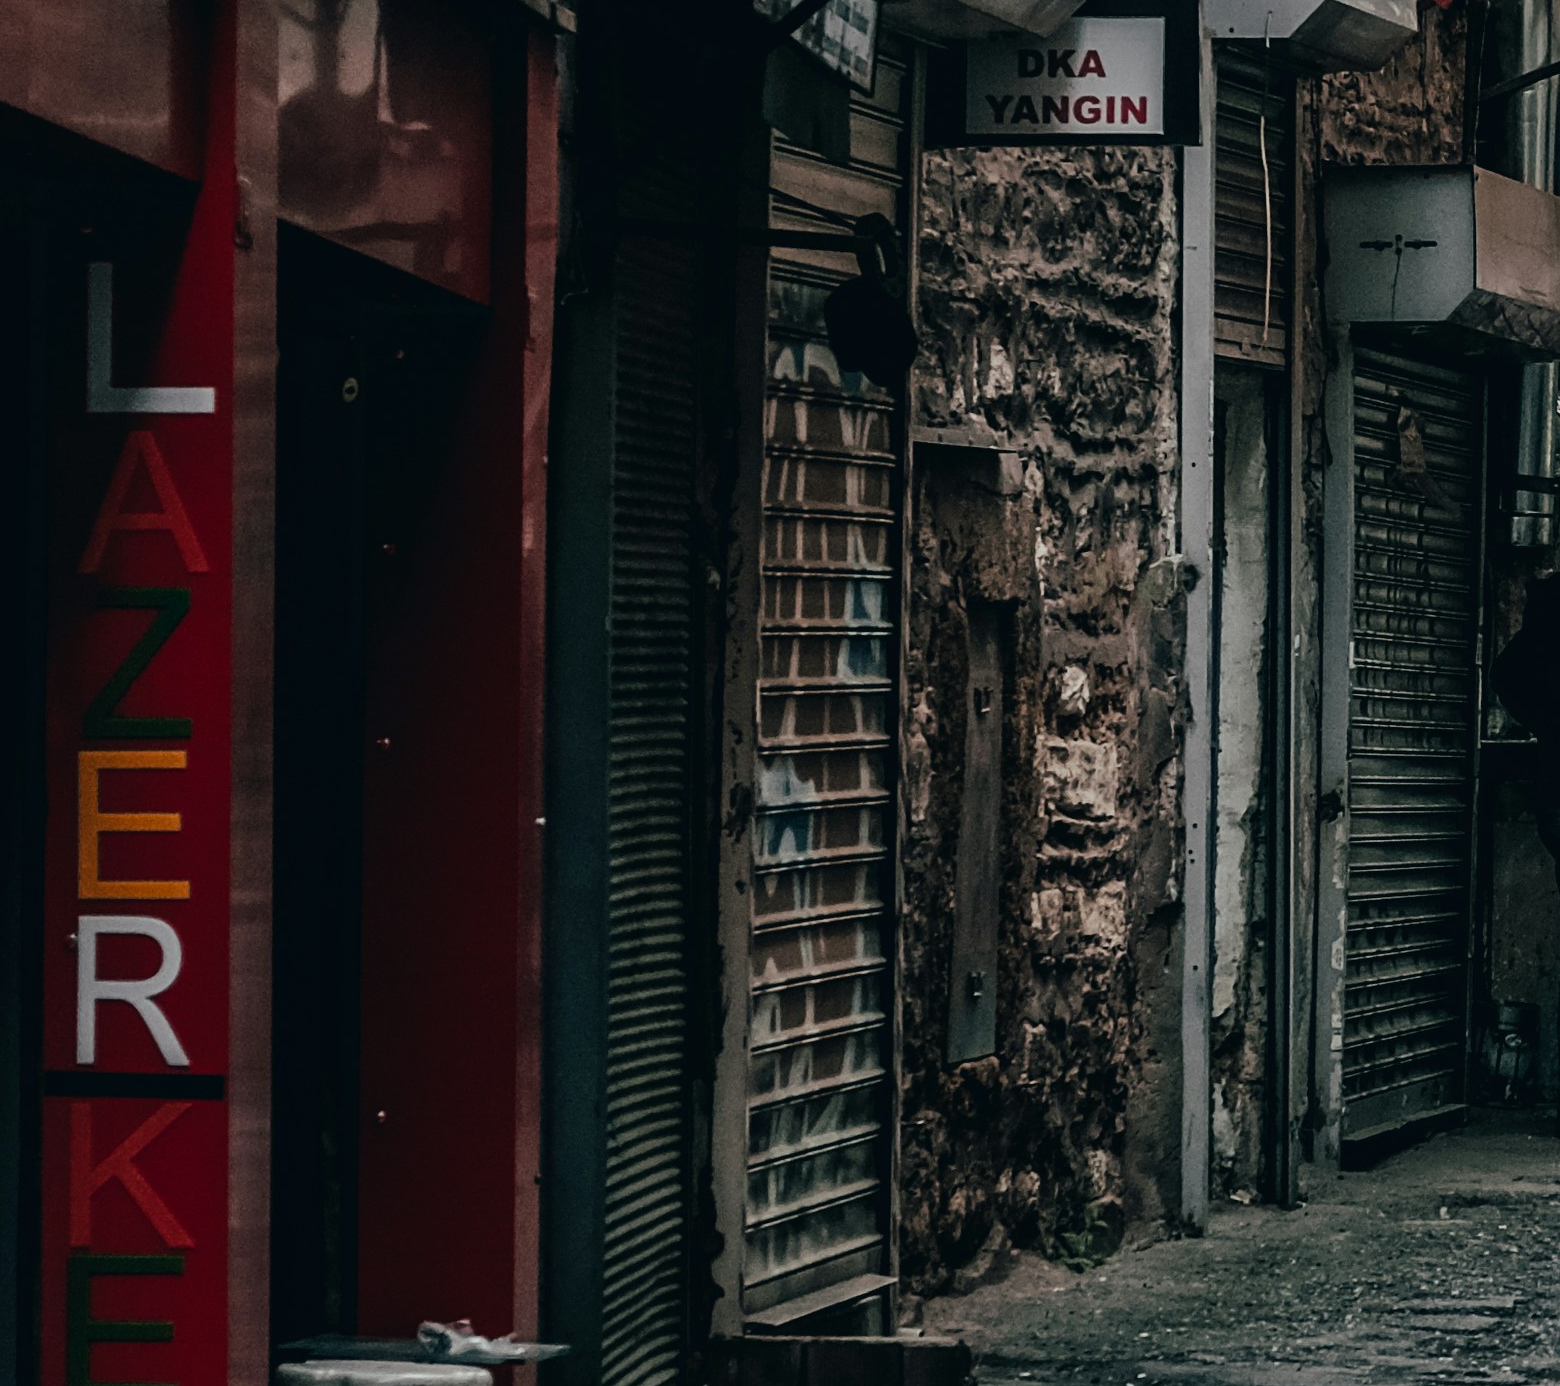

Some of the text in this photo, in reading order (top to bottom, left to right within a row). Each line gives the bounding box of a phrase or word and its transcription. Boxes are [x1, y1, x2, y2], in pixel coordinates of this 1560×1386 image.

[1018, 49, 1106, 78] DKA
[985, 95, 1148, 124] YANGIN
[75, 261, 216, 1068] LAZER
